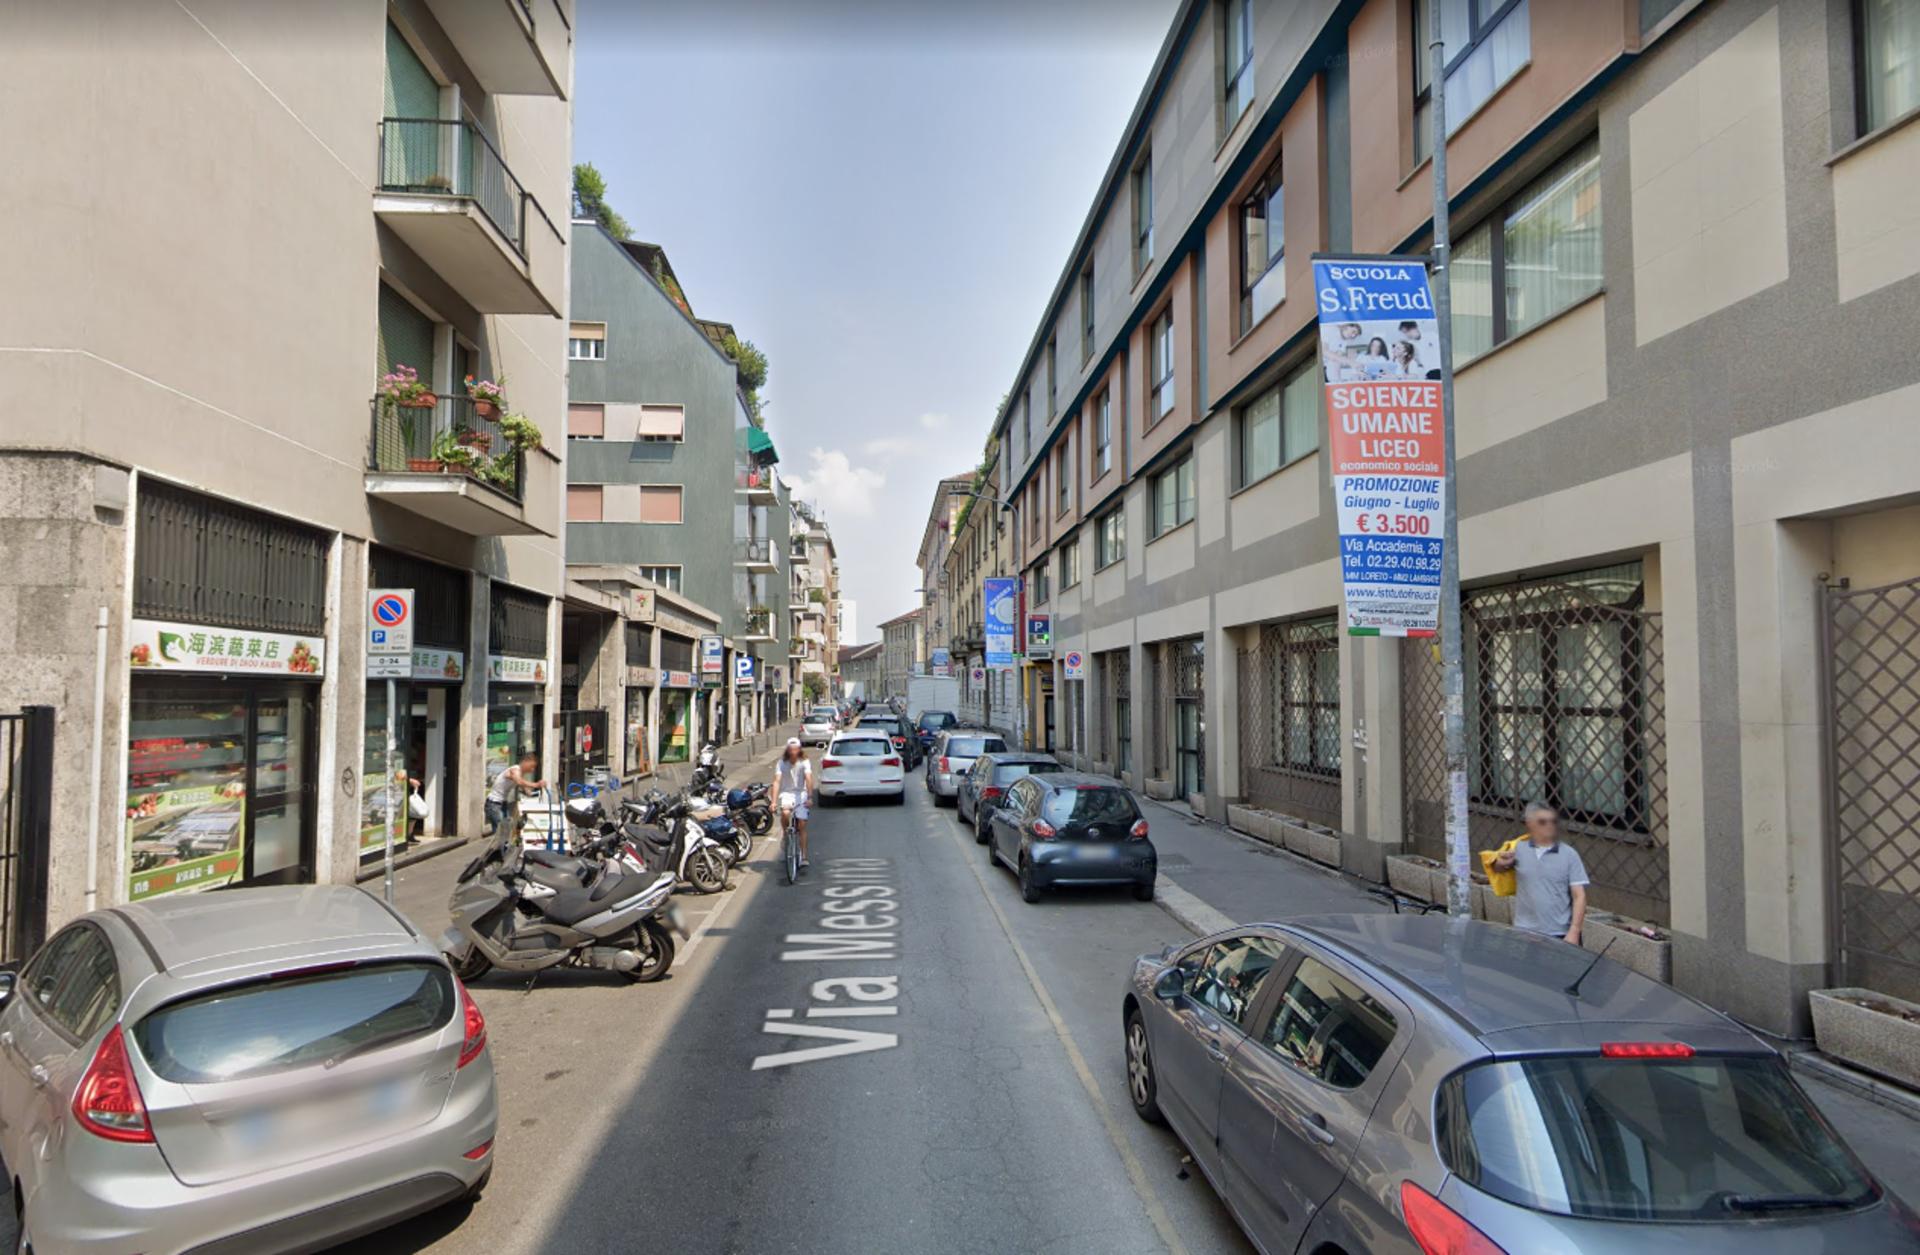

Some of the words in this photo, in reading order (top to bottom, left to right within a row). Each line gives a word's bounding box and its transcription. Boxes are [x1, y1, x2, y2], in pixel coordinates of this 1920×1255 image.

[1330, 267, 1411, 280] SCUOLA
[1320, 286, 1431, 312] S.Freud
[1332, 386, 1438, 409] SCIENZE
[1342, 412, 1433, 434] UMANE
[1360, 439, 1420, 458] LICEO
[1340, 461, 1401, 471] economico
[1403, 462, 1440, 472] sociale
[1343, 477, 1440, 494] PROMOZIONE
[1344, 495, 1391, 510] Giugno
[1404, 496, 1440, 512] Luglio
[1356, 513, 1370, 532] €
[1376, 513, 1430, 535] 3.500
[1345, 538, 1363, 552] Via
[1366, 539, 1426, 556] Accademia,
[1344, 554, 1364, 568] Tel.
[1034, 621, 1044, 632] P
[737, 659, 752, 677] P
